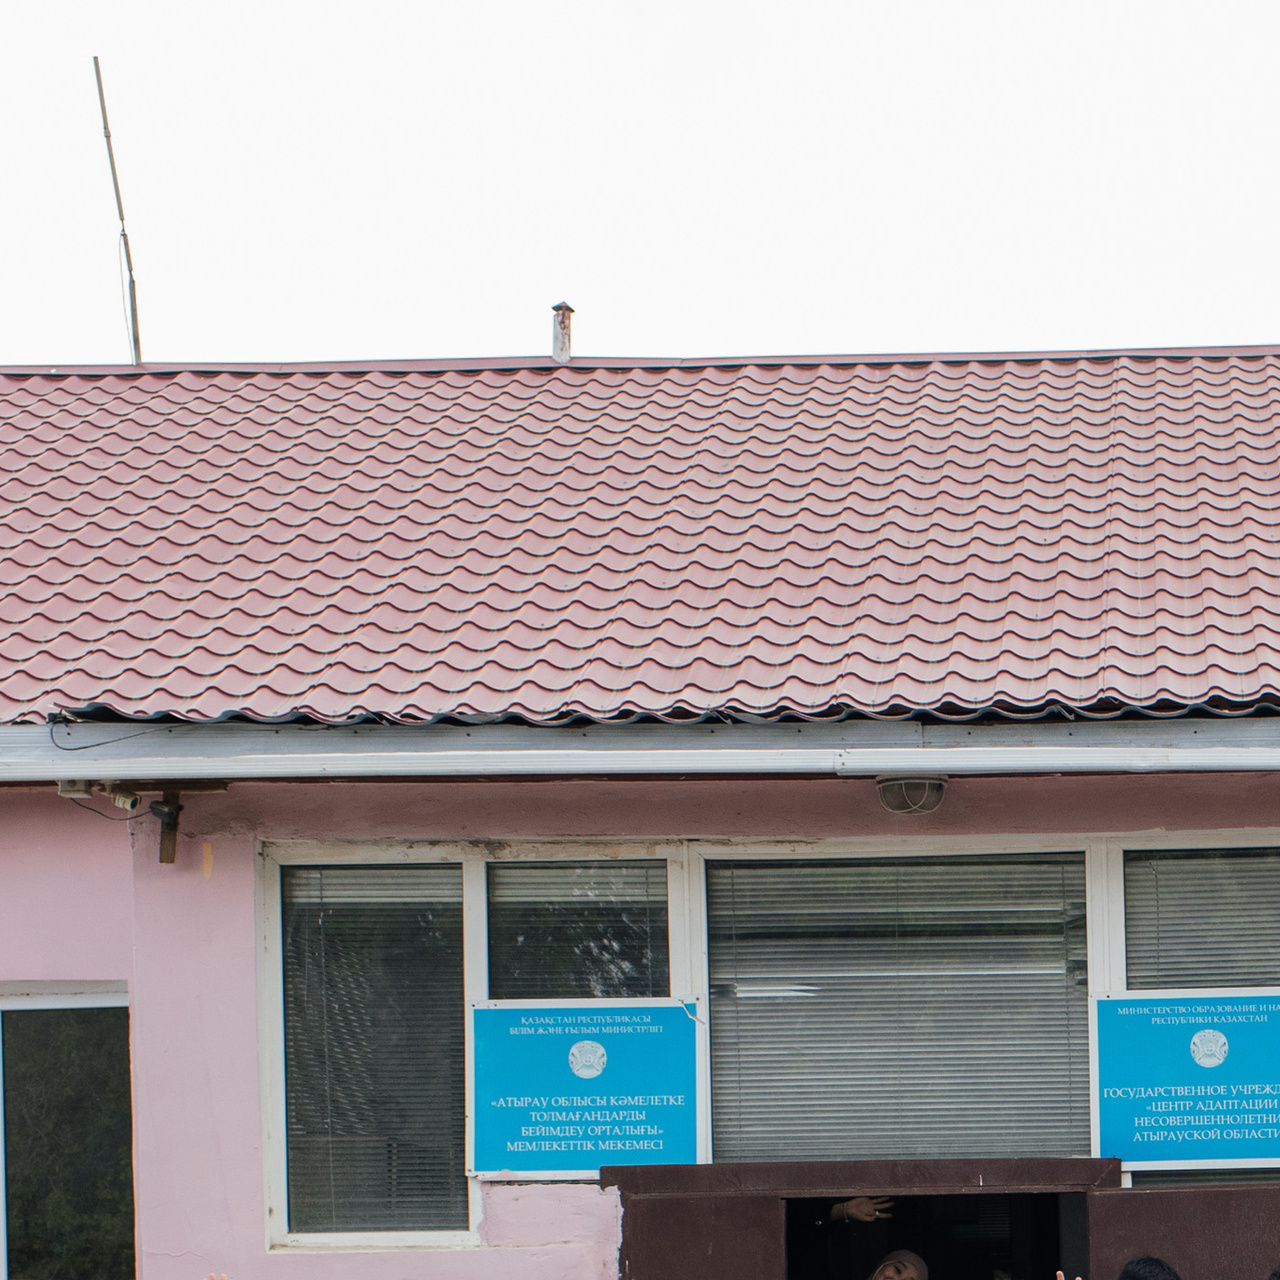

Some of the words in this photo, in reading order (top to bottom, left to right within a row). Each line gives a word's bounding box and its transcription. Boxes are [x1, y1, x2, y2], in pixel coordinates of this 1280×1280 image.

[1117, 1006, 1191, 1015] МИНИСТЕРСТВО
[1192, 1004, 1258, 1014] ОБРАЗОВАНИЕ
[1259, 1004, 1267, 1012] И
[577, 1015, 651, 1024] РЕСПУБЛИКАСЫ
[1151, 1016, 1212, 1025] РЕСПУБЛИКИ
[1213, 1015, 1268, 1023] КАЗАХСТАН
[1103, 1085, 1228, 1099] ГОСУДАРСТВЕННОЕ
[491, 1097, 549, 1108] «АТЫРАУ
[551, 1096, 607, 1107] ОБЛЫСЫ
[609, 1095, 685, 1106] КӘМЕЛЕТКЕ
[1146, 1101, 1194, 1113] «ЦЕНТР
[1196, 1099, 1278, 1112] АДАПТАЦИИ
[530, 1110, 646, 1122] ТОЛМАҒАНДАРДЫ
[521, 1125, 585, 1138] БЕЙІМДЕУ
[1133, 1128, 1221, 1142] АТЫРАУСКОЙ
[506, 1140, 596, 1152] МЕМЛЕКЕТТІК
[598, 1139, 663, 1150] МЕКЕМЕСІ
